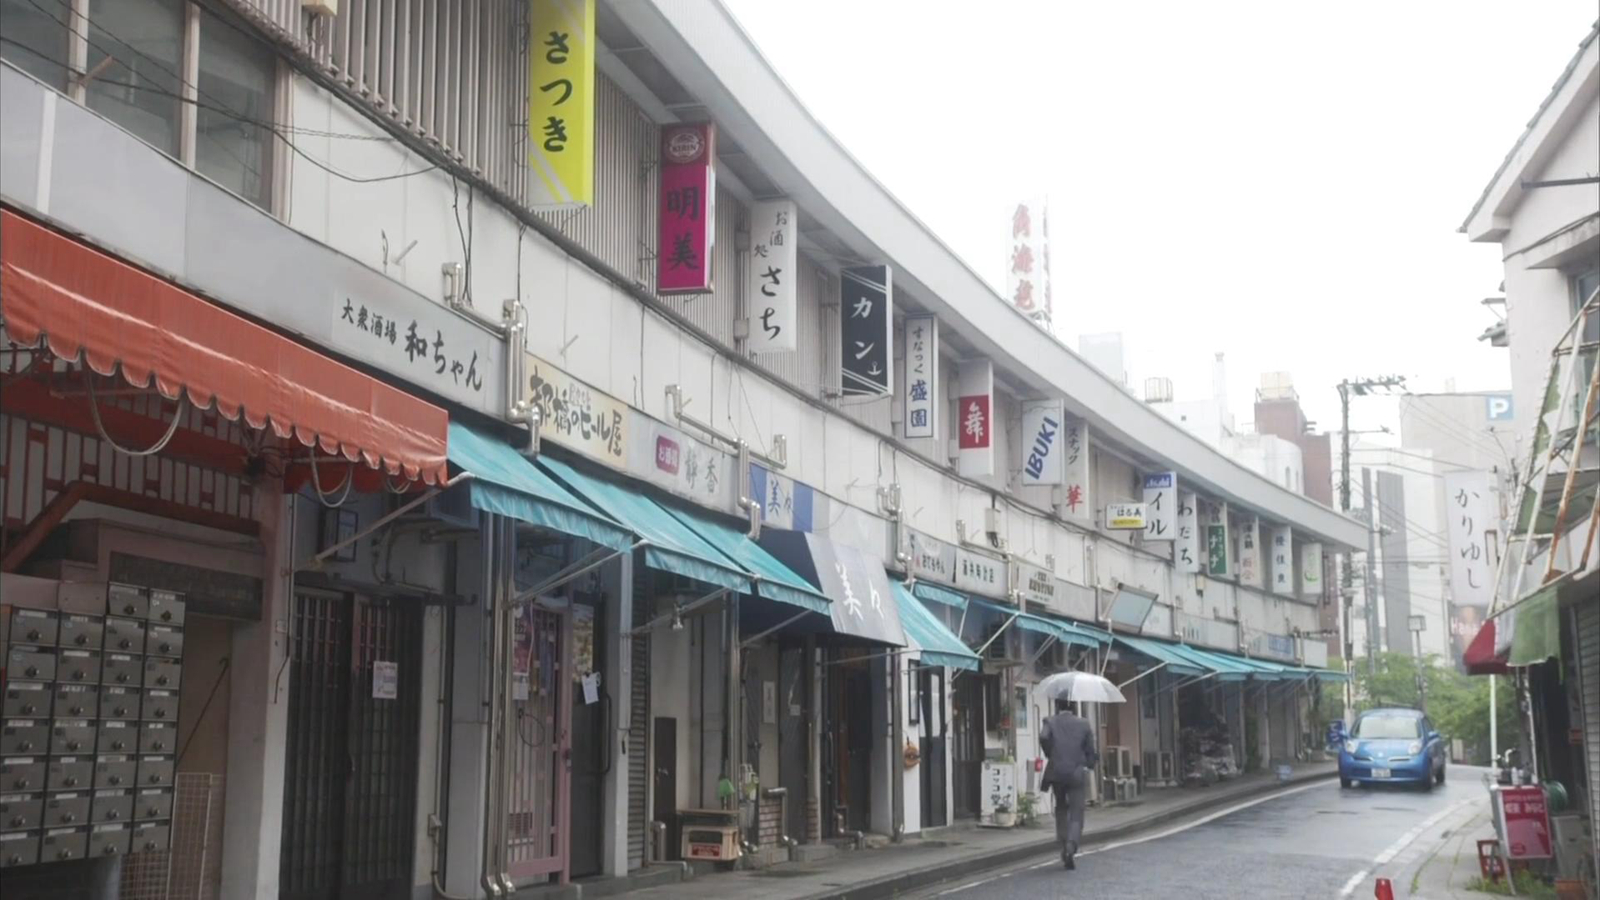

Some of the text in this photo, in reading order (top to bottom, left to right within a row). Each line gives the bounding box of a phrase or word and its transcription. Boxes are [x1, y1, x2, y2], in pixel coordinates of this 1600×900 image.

[540, 31, 572, 152] さつき
[666, 186, 699, 271] 明美
[760, 266, 783, 341] さち
[851, 297, 874, 360] カン
[341, 298, 482, 392] 大衆酒場 和ちゃん
[912, 326, 924, 374] すなっく
[964, 402, 984, 444] 舞
[1490, 399, 1509, 419] P
[1025, 416, 1058, 480] IBUKI
[1068, 427, 1080, 465] スナック
[1066, 485, 1083, 513] 華
[1149, 491, 1167, 535] イル
[1455, 488, 1481, 589] かりゆし
